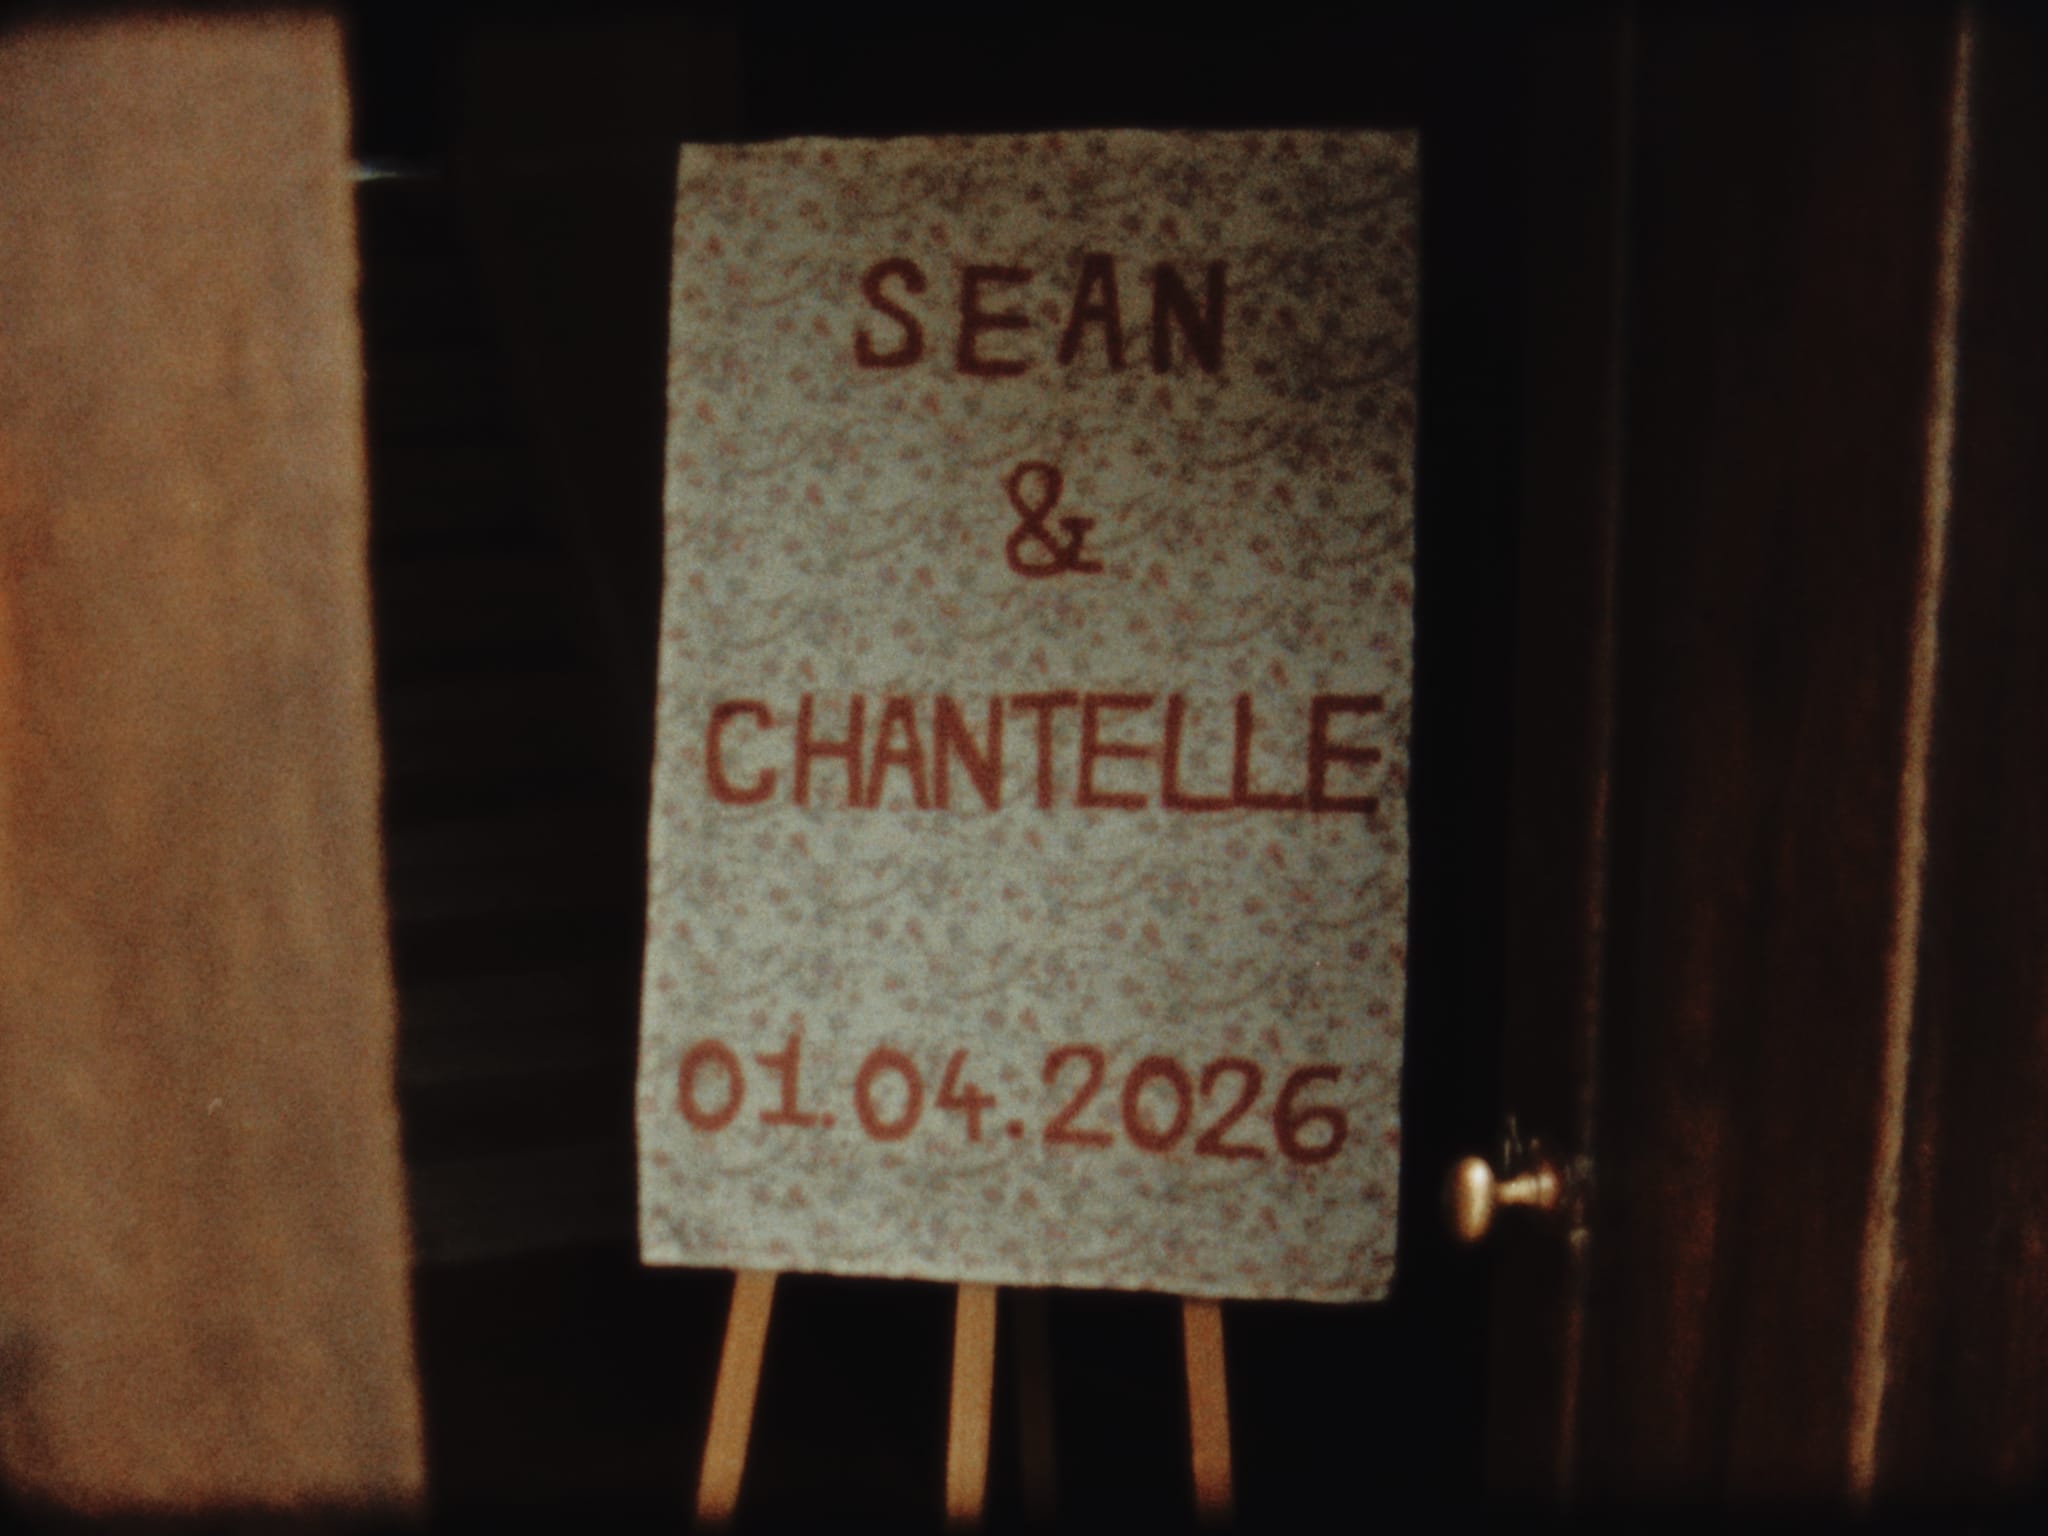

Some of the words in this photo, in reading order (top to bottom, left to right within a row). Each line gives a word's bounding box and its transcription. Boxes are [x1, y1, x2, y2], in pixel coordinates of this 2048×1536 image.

[855, 254, 1227, 377] SEAN
[1006, 461, 1103, 577] &
[705, 691, 1383, 813] CHANTELLE
[677, 1031, 1349, 1164] 01.04.2026
